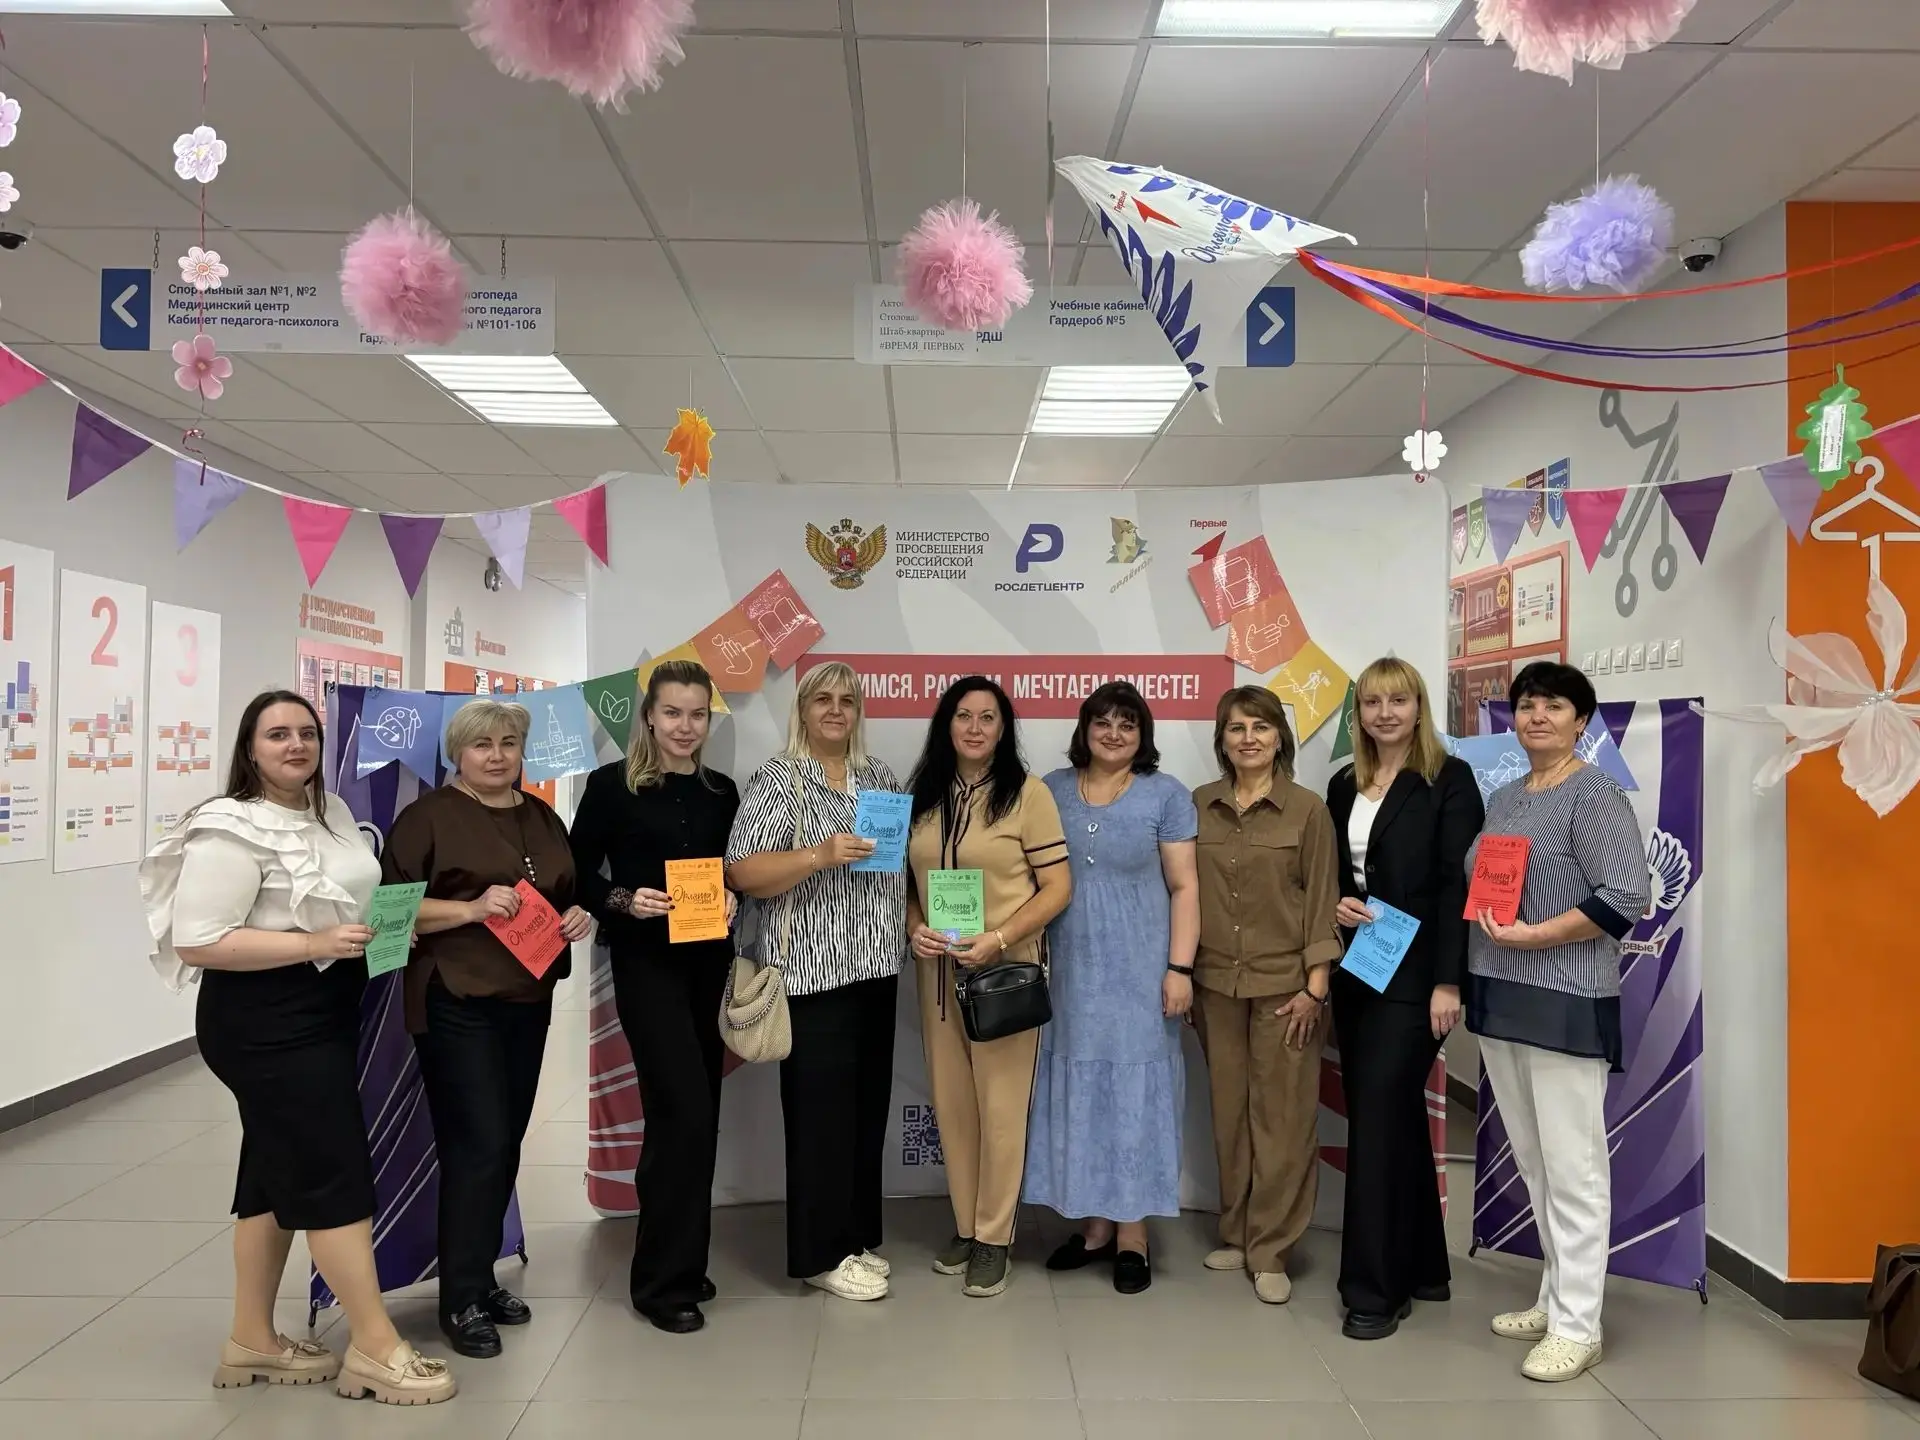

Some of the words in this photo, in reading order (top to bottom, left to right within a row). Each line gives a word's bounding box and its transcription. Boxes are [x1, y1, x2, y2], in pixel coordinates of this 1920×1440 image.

[168, 284, 244, 296] Споривный
[246, 288, 267, 296] зал
[270, 286, 293, 297] №1,
[296, 286, 317, 296] №2
[168, 299, 251, 311] Медицинский
[254, 303, 290, 313] центр
[880, 299, 905, 308] Акто
[1050, 300, 1100, 311] Учебные
[1103, 300, 1149, 311] кабинет
[490, 306, 542, 316] педагога
[880, 312, 918, 321] Столова
[168, 314, 218, 325] Кабинет
[220, 316, 339, 327] педагога-психолога
[476, 319, 536, 330] №101-106
[1049, 315, 1103, 327] Гардероб
[1106, 315, 1126, 326] №5
[880, 326, 945, 337] Штаб-квартира
[976, 331, 1003, 344] РДШ
[1190, 519, 1228, 530] Первые
[896, 531, 990, 542] МИНИСТЕРСТВО
[896, 543, 984, 555] ПРОСВЕЩЕНИЯ
[896, 555, 973, 567] РОССИЙСКОЙ
[896, 568, 967, 580] ФЕДЕРАЦИИ
[994, 582, 1085, 592] РОСДЕТЦЕНТР
[91, 595, 119, 668] 2
[176, 623, 200, 688] 3
[857, 673, 919, 702] ИМСЯ,
[1013, 674, 1108, 699] МЕЧТАЕМ
